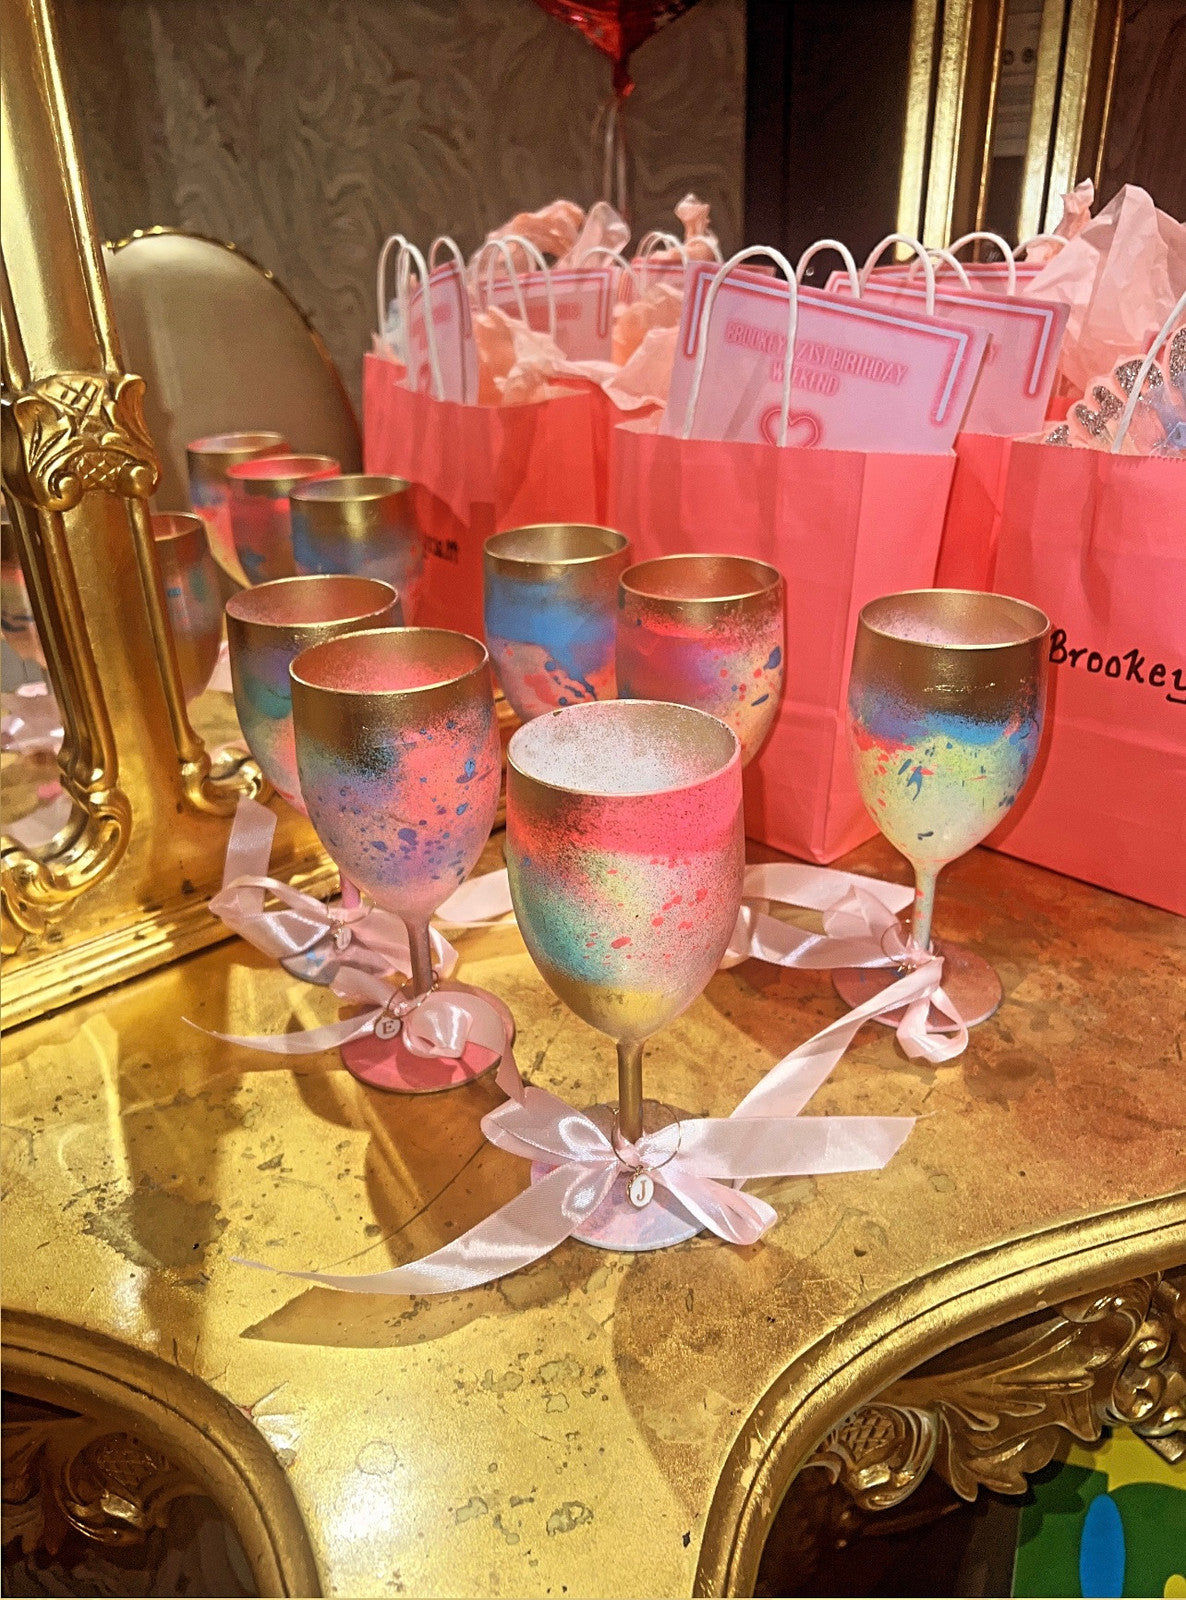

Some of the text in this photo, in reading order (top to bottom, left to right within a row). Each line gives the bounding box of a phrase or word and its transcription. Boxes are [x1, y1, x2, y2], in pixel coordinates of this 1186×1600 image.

[770, 360, 840, 395] WEKEND
[831, 348, 908, 385] BIRTHDAY
[382, 1020, 396, 1035] E
[636, 1180, 647, 1201] J
